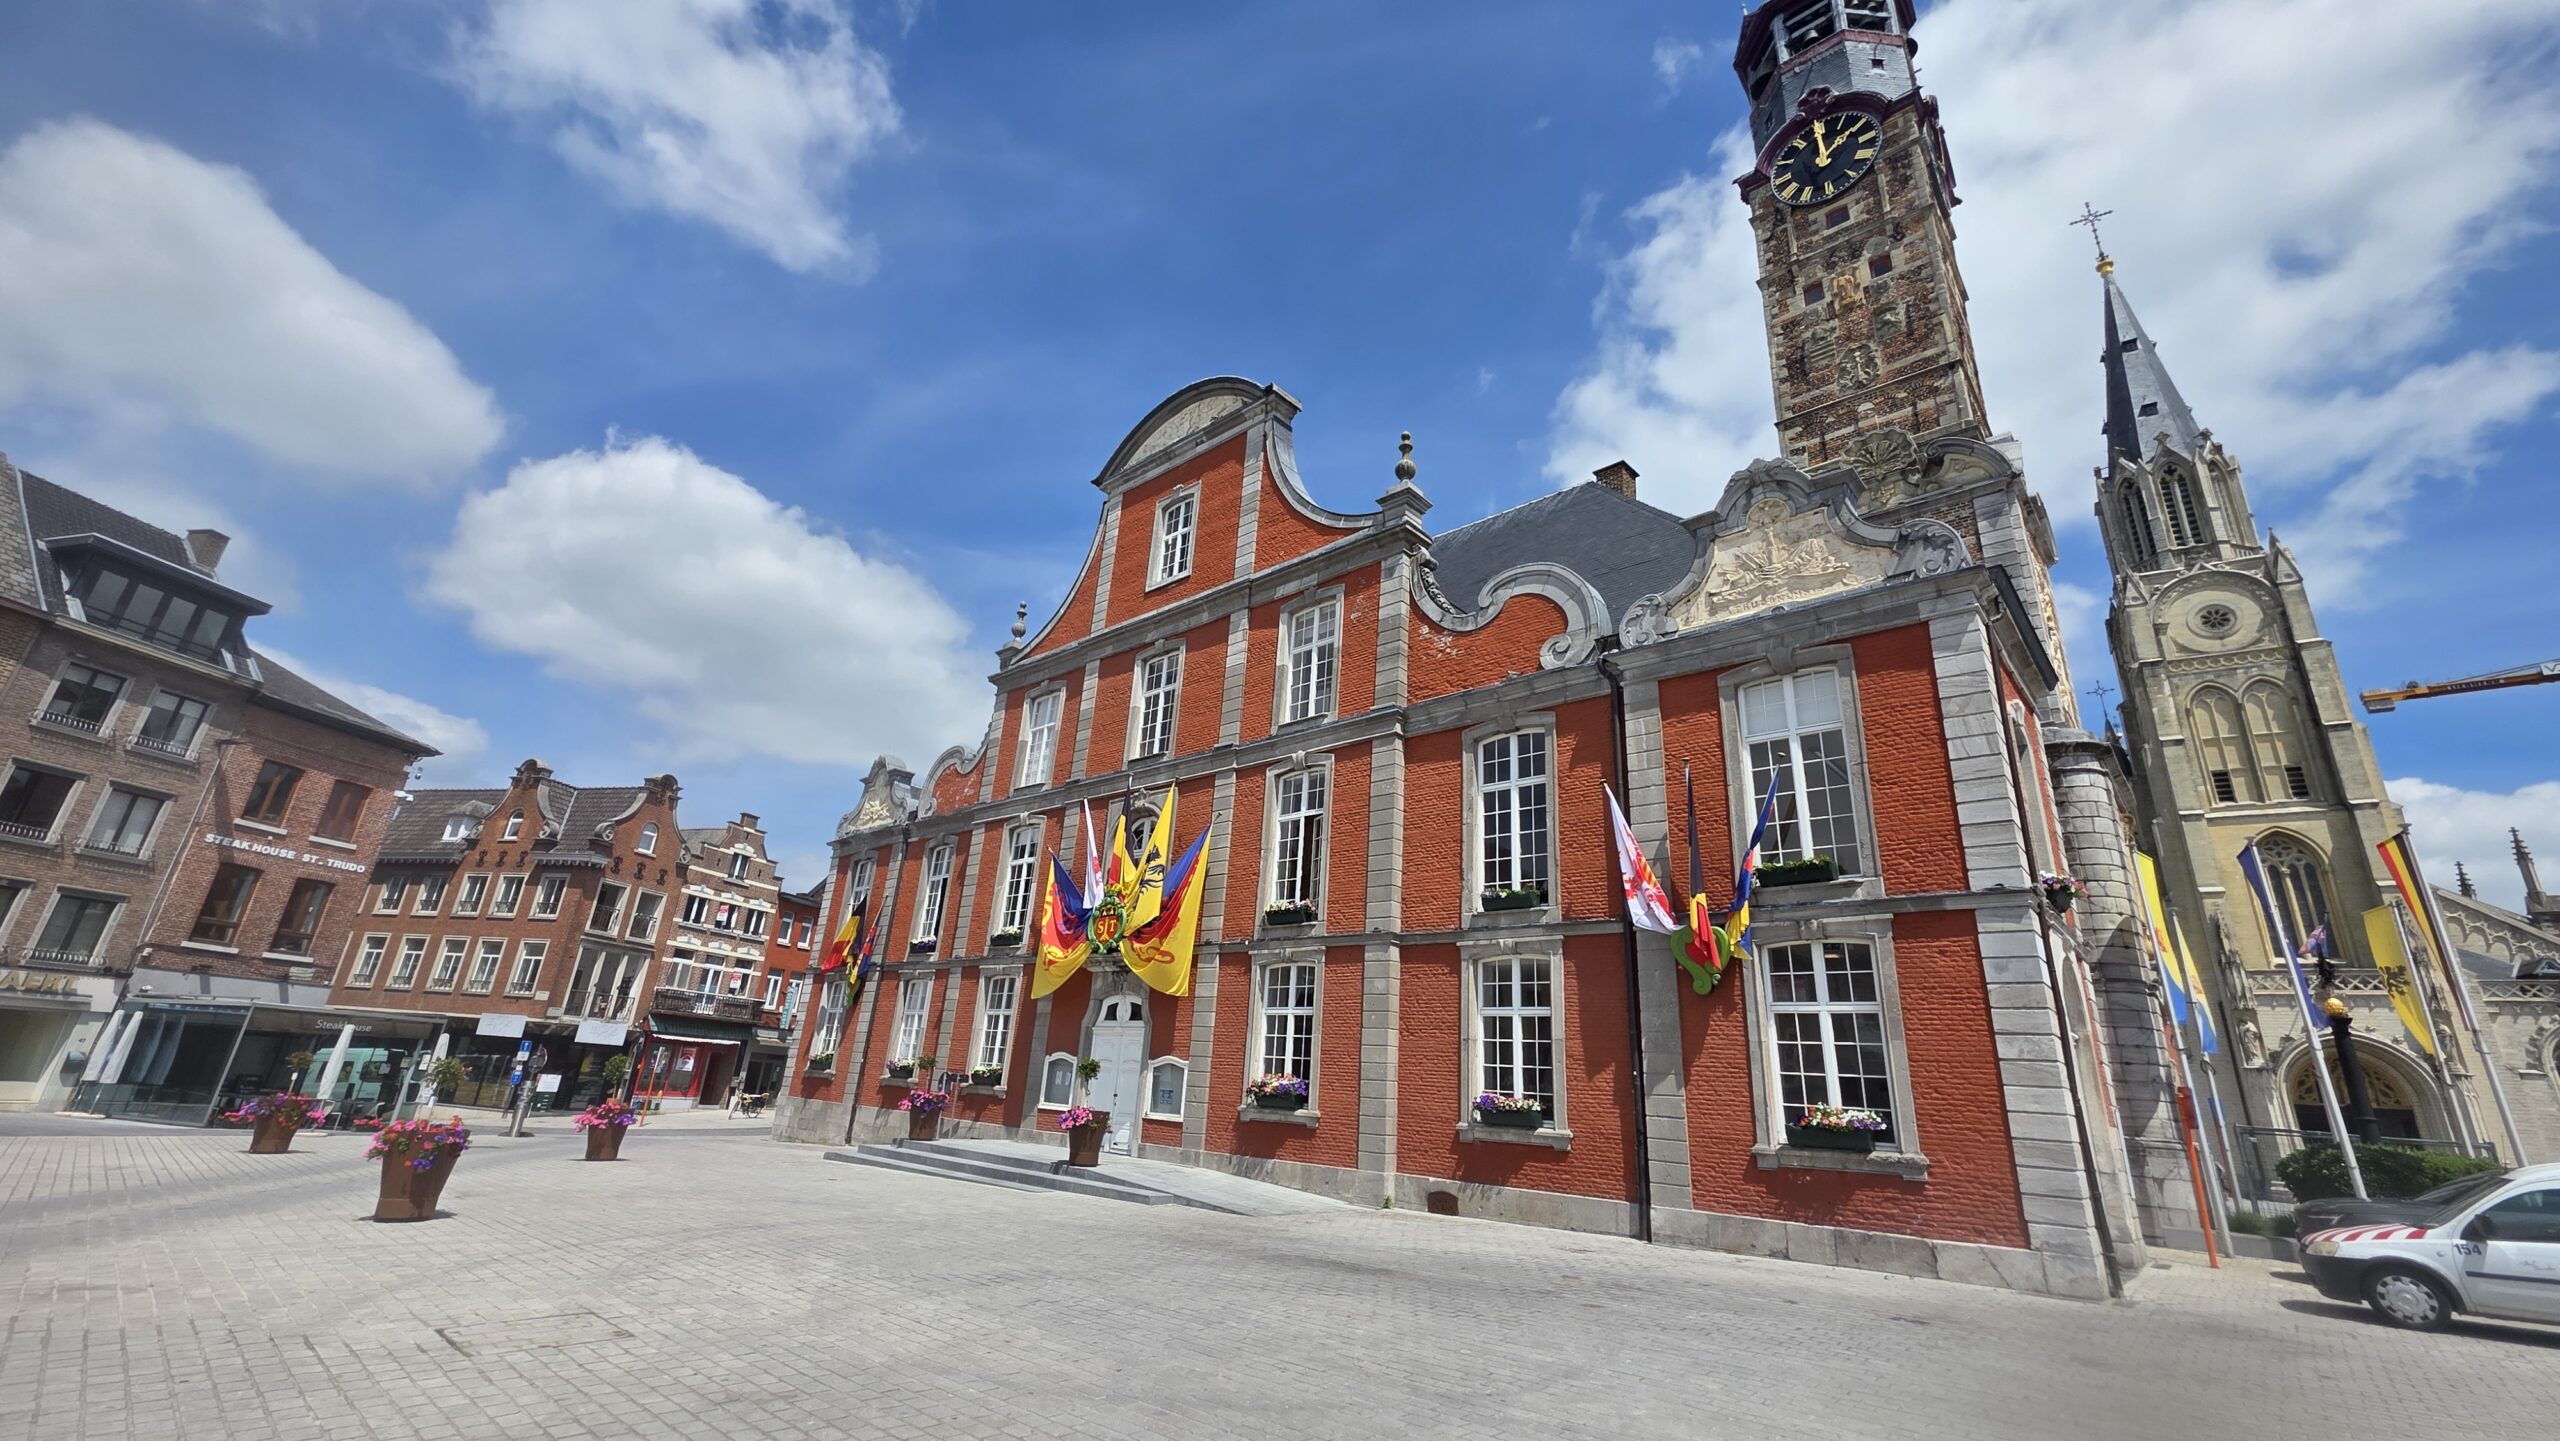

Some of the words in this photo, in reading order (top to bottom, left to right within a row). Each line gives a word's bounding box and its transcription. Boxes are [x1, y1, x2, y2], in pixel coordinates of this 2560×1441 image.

[204, 833, 251, 850] STEAK
[251, 843, 297, 860] HOUSE
[327, 858, 366, 873] TRUDO
[1097, 920, 1104, 934] S
[1110, 919, 1117, 932] T
[315, 1019, 372, 1032] Steakuse
[2453, 1243, 2482, 1256] 154
